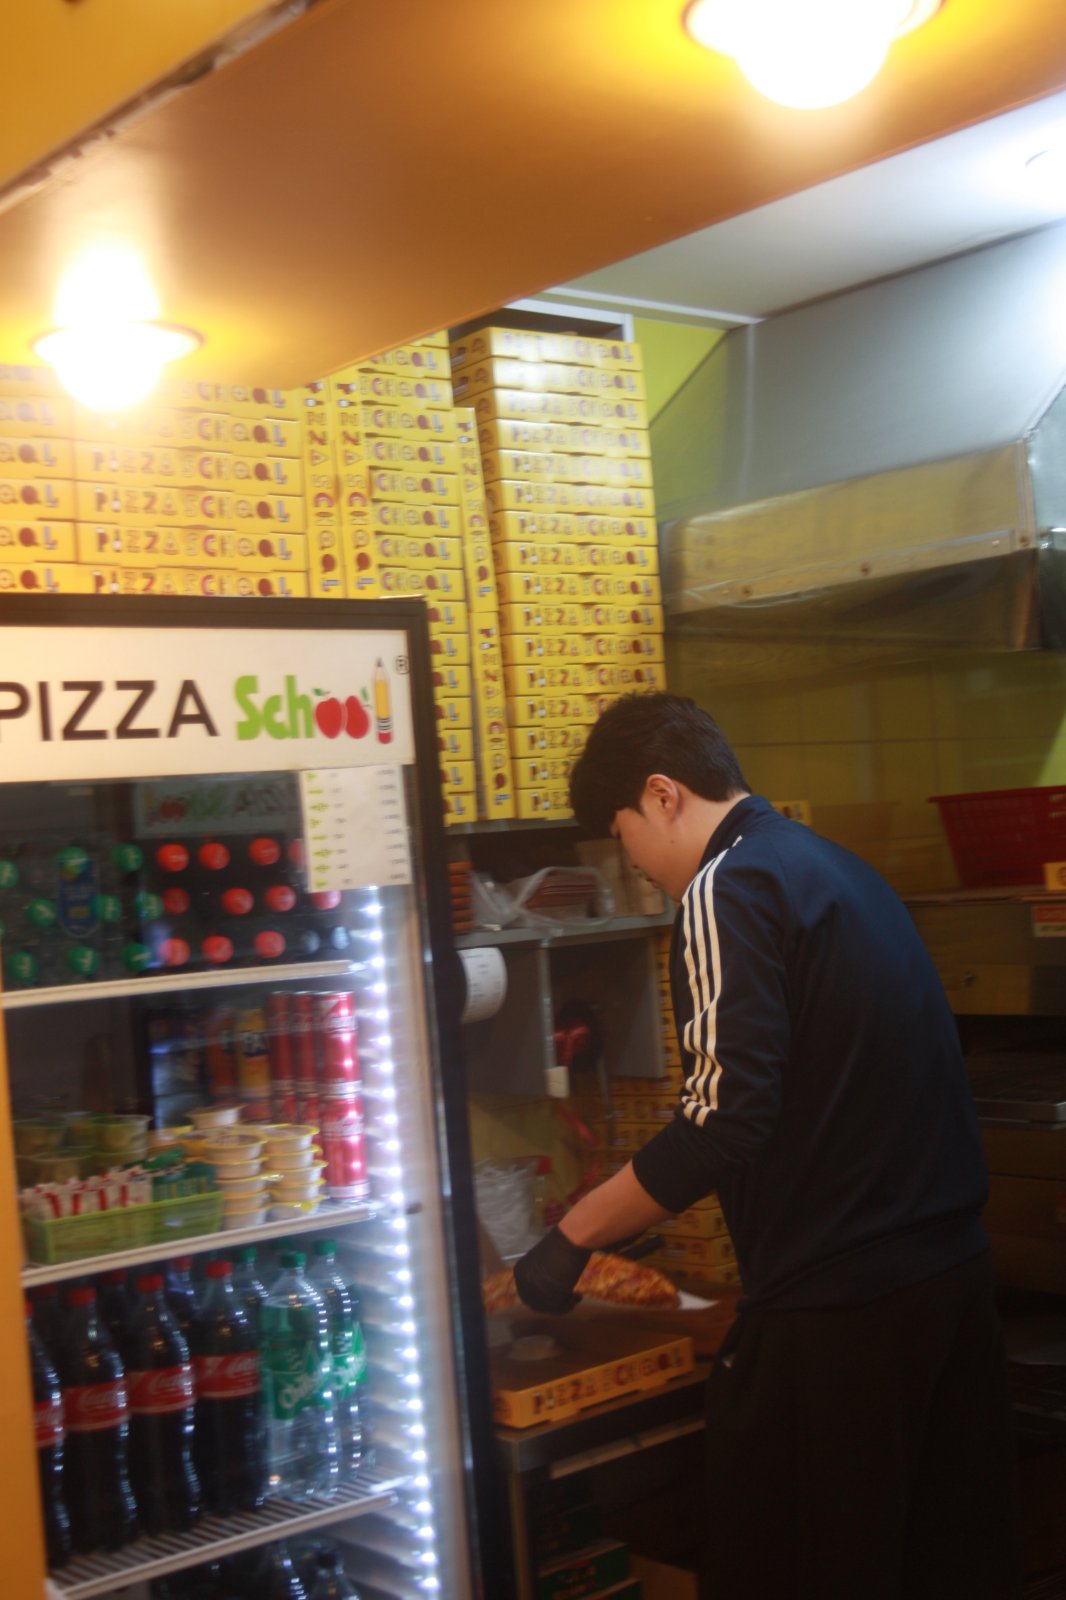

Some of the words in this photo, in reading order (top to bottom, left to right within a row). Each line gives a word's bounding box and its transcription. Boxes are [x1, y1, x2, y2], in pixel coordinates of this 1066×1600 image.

[94, 486, 178, 516] PIZZA
[183, 493, 291, 523] SCHOOL
[517, 515, 574, 536] PIZZA
[95, 526, 180, 556] PIZZA
[184, 531, 293, 561] SCHOOL
[518, 545, 576, 566] PIZZA
[578, 546, 649, 568] SCHOOL
[92, 568, 177, 594] PIZZA
[523, 575, 577, 596] PIZZA
[582, 576, 653, 597] SCHOOL
[522, 607, 579, 626] PIZZA
[583, 606, 654, 626] SCHOOL
[524, 637, 580, 657] PIZZA
[583, 637, 656, 656] SCHOOL
[526, 667, 582, 688] PIZZA
[585, 666, 657, 687] SCHOOL
[0, 679, 219, 742] PIZZA
[527, 699, 584, 719] PIZZA
